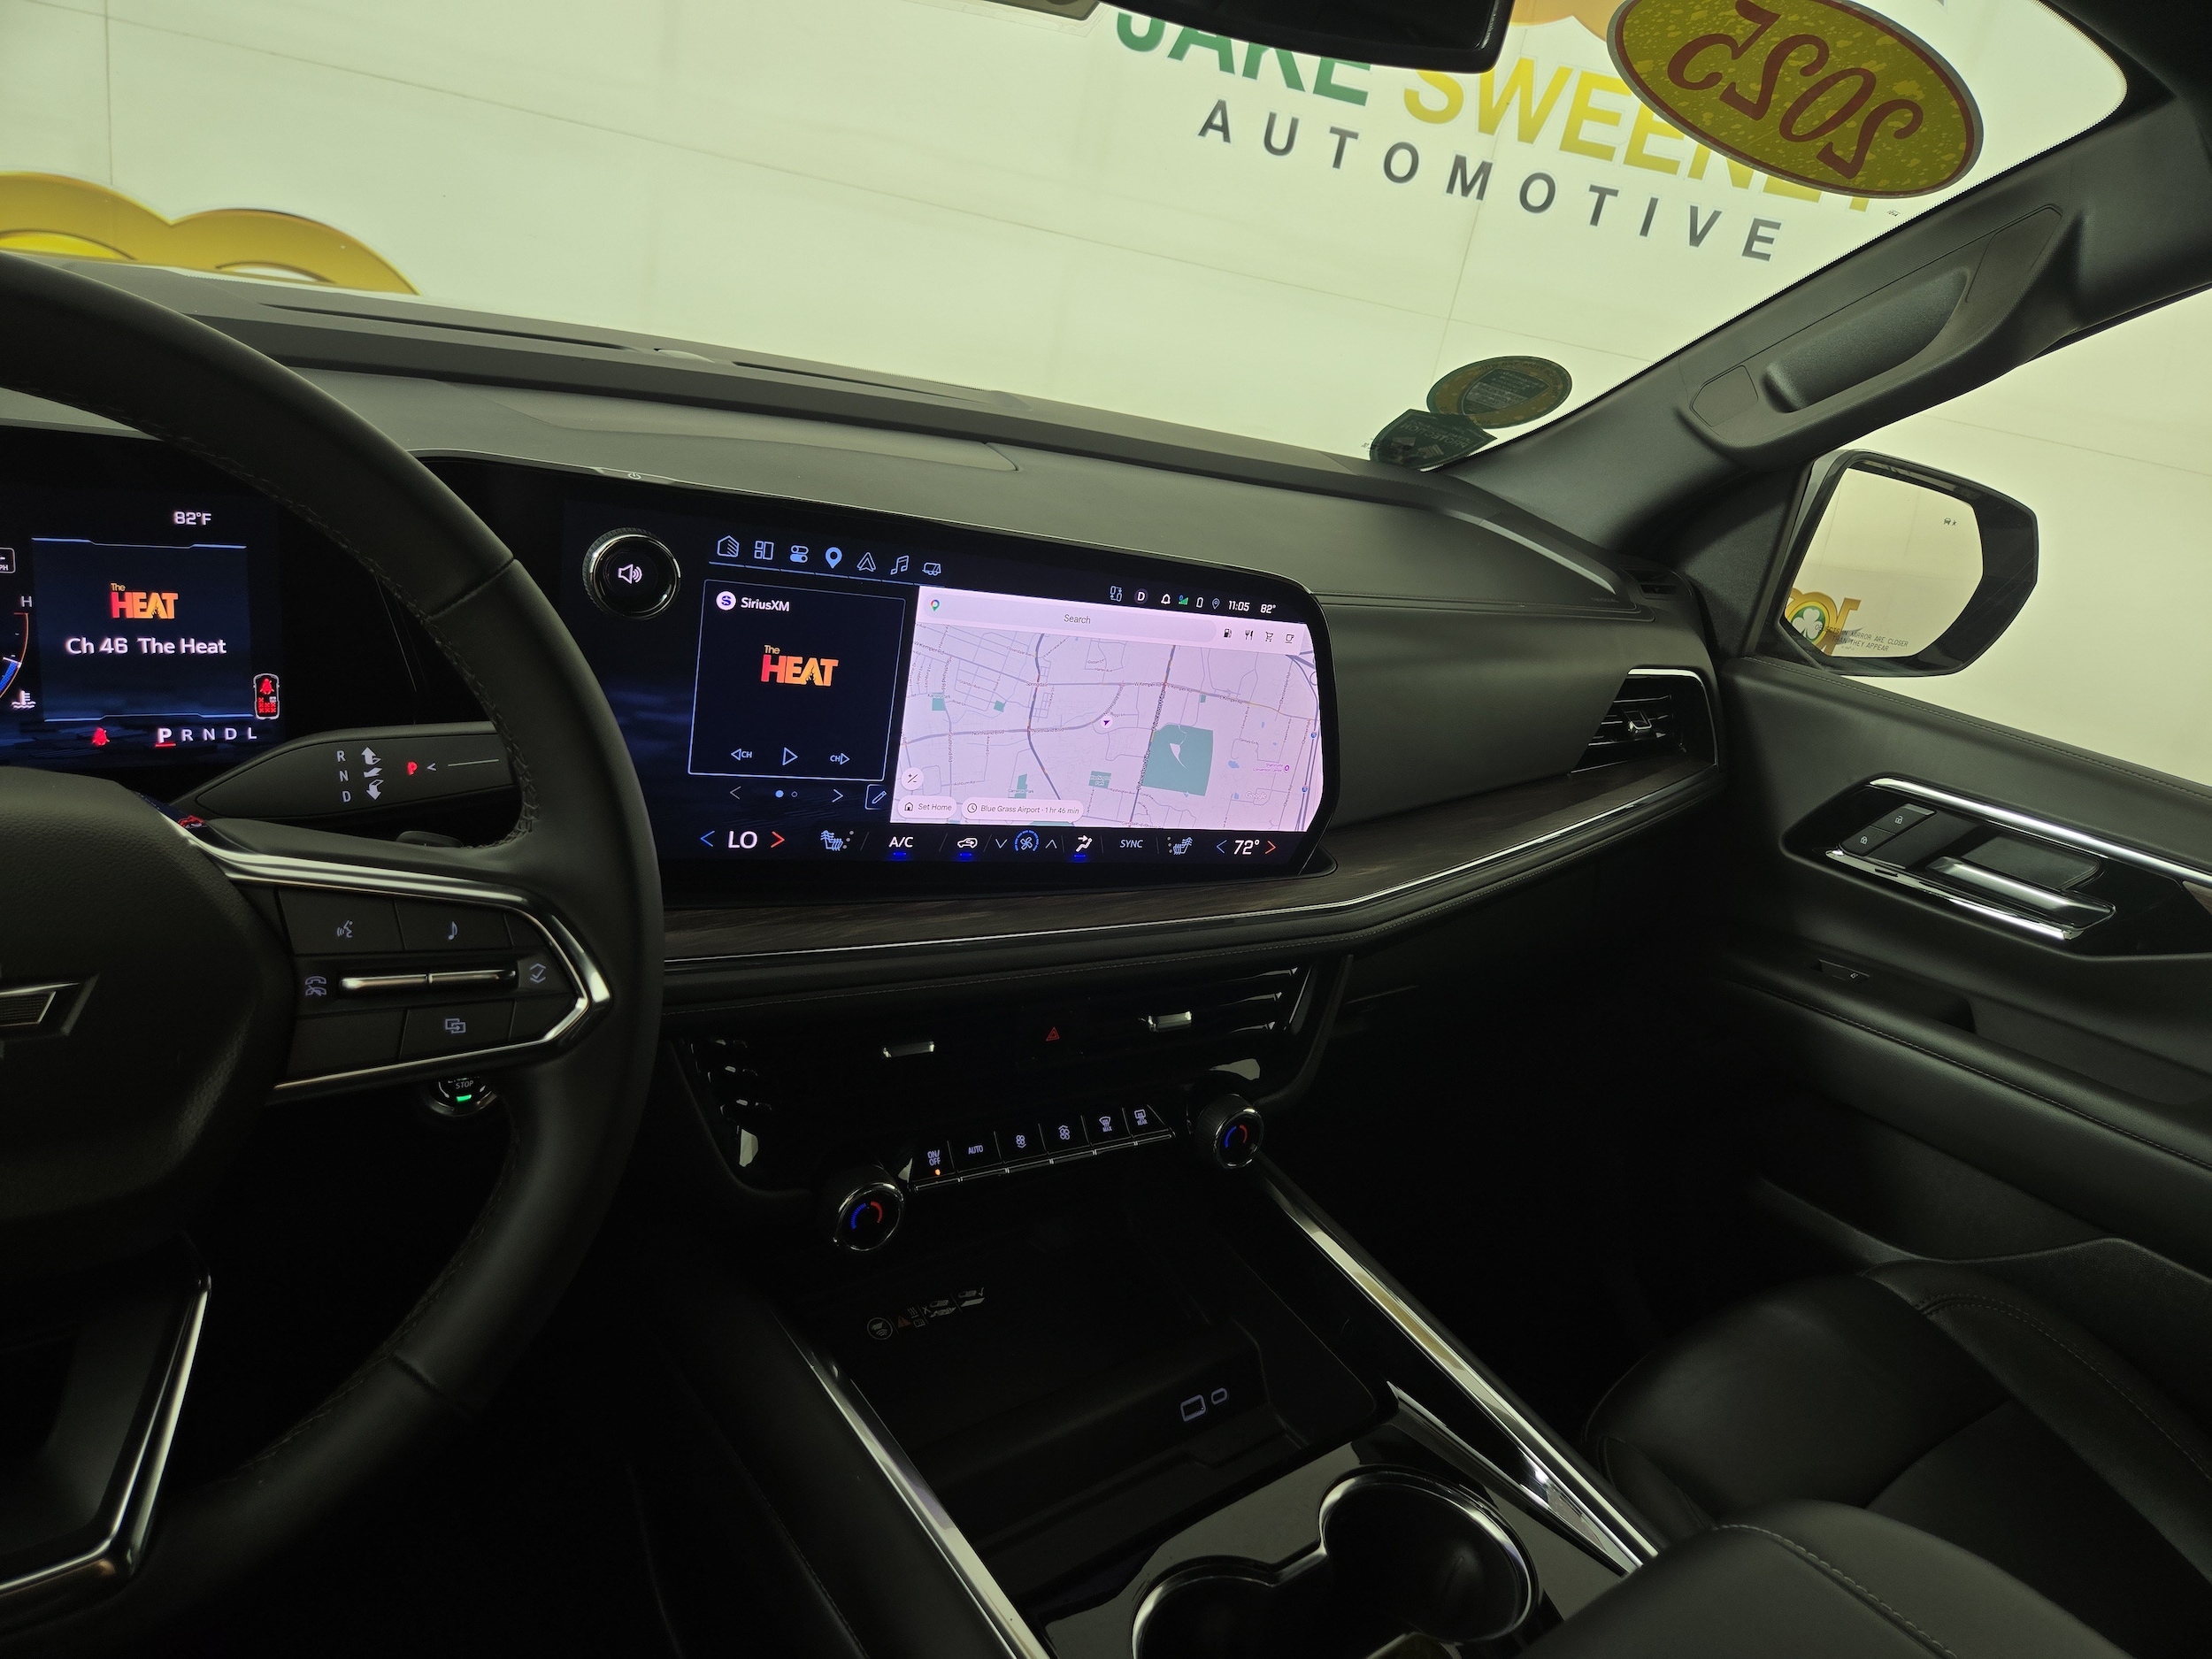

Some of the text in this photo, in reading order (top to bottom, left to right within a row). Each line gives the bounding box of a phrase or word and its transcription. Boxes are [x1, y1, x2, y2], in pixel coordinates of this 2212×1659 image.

[1198, 99, 1783, 261] AUTOMOTIVE
[174, 510, 212, 526] 82°F
[110, 582, 126, 592] The
[110, 592, 180, 619] HEAT
[741, 596, 790, 612] SiriusXM
[1228, 600, 1250, 612] 11:05
[1260, 603, 1276, 614] 82°
[1064, 614, 1091, 626] Search
[1815, 624, 1839, 634] OBJECTS
[1851, 631, 1872, 641] MIRROR
[1887, 637, 1909, 647] CLOSER
[66, 637, 227, 655] Ch 46 The Heat
[764, 644, 780, 655] The
[1832, 635, 1847, 644] THAN
[1866, 642, 1889, 651] APPEAR
[760, 654, 839, 687] HEAT
[158, 727, 257, 743] P R N D L
[337, 750, 346, 762] R
[741, 750, 752, 759] CH
[830, 753, 841, 763] CH
[406, 760, 418, 775] P
[339, 769, 349, 781] N
[342, 790, 351, 803] D
[1246, 791, 1267, 800] Google
[932, 803, 952, 812] Home
[727, 830, 758, 849] LO
[889, 836, 914, 849] A/C
[1120, 839, 1143, 849] SYNC
[1233, 839, 1260, 856] 72°
[456, 1080, 474, 1089] STOP
[927, 1150, 941, 1159] ON/
[968, 1145, 983, 1155] AUTO
[929, 1157, 941, 1166] OFF
